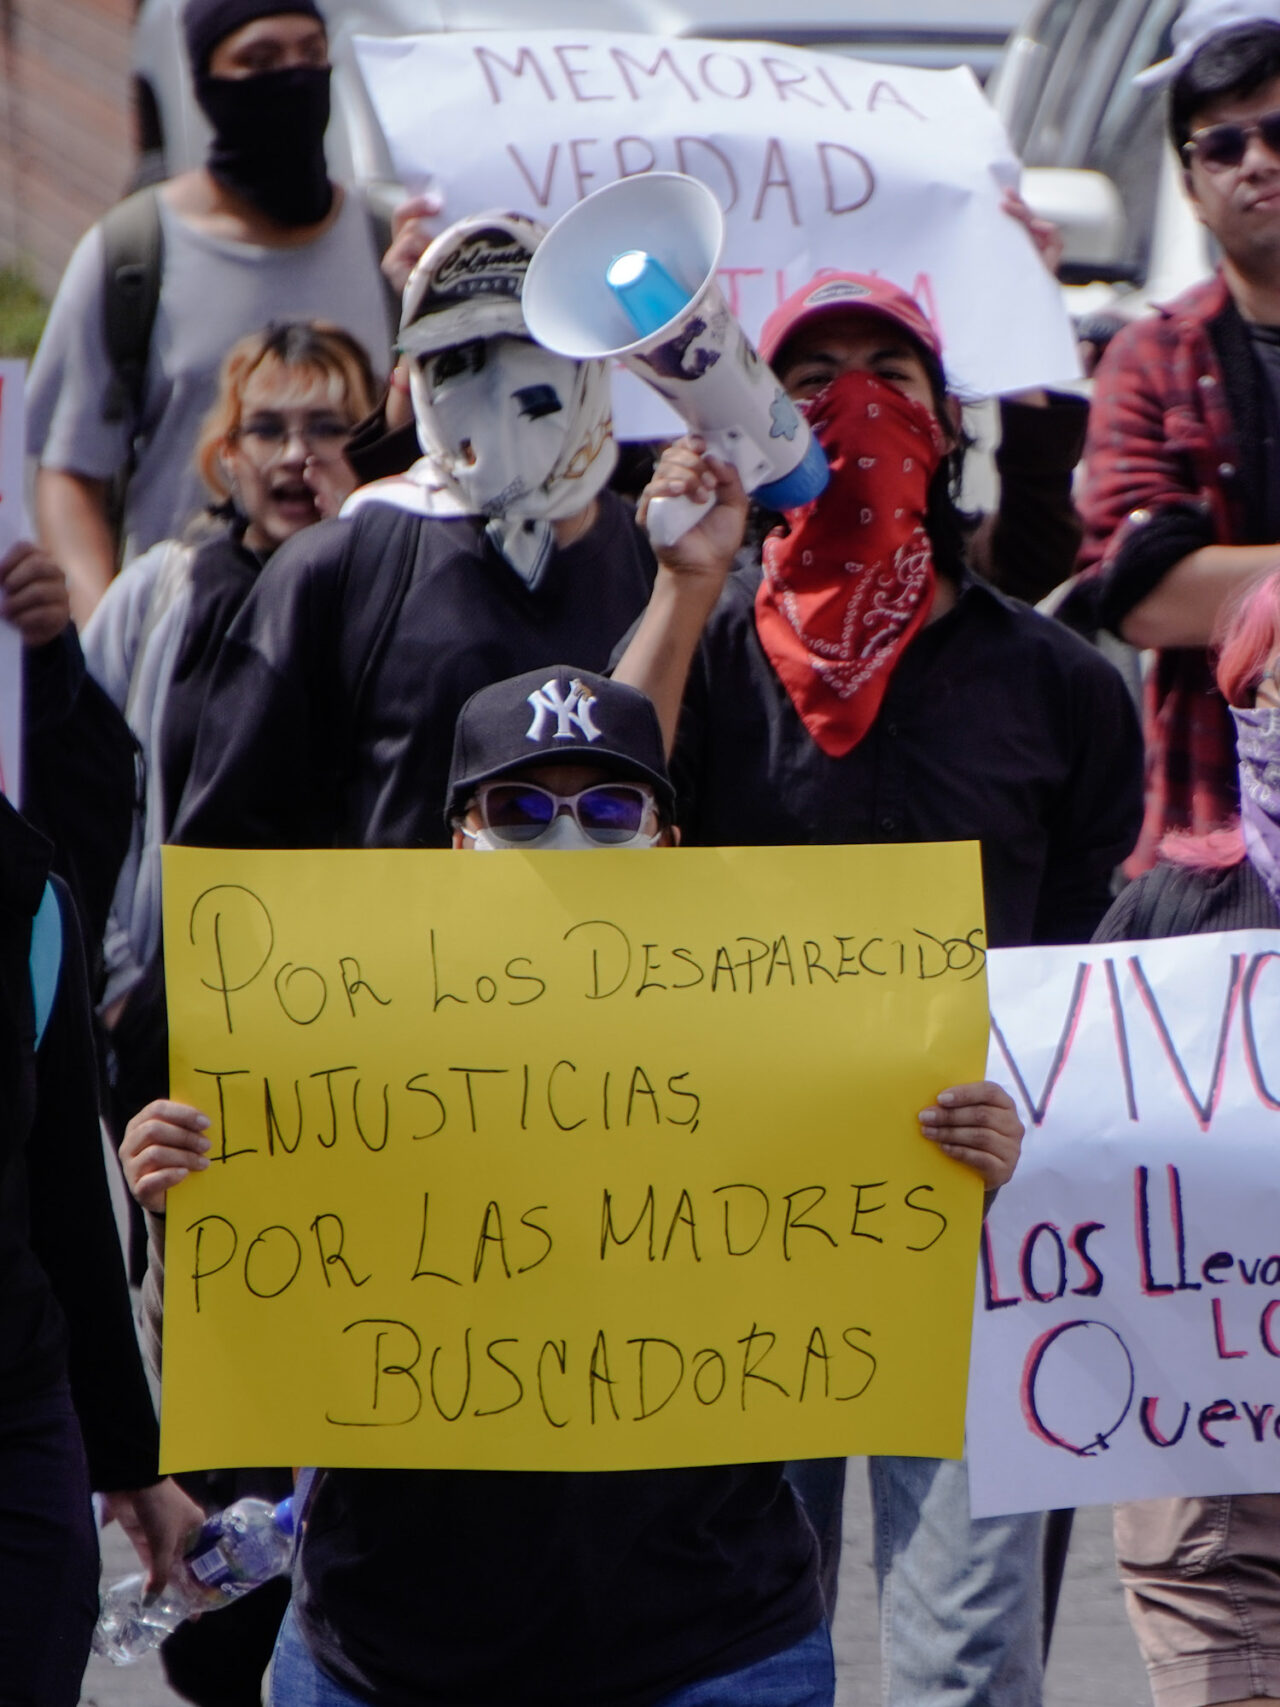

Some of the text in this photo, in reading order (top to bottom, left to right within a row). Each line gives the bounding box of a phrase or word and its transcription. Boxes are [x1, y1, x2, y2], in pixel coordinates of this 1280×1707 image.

[474, 44, 928, 121] MEMORIA
[526, 678, 602, 742] NY
[563, 919, 988, 999] DESAPARECIDOS
[186, 1181, 948, 1314] POR LAS MADRES
[325, 1319, 877, 1428] BUSCADORAS
